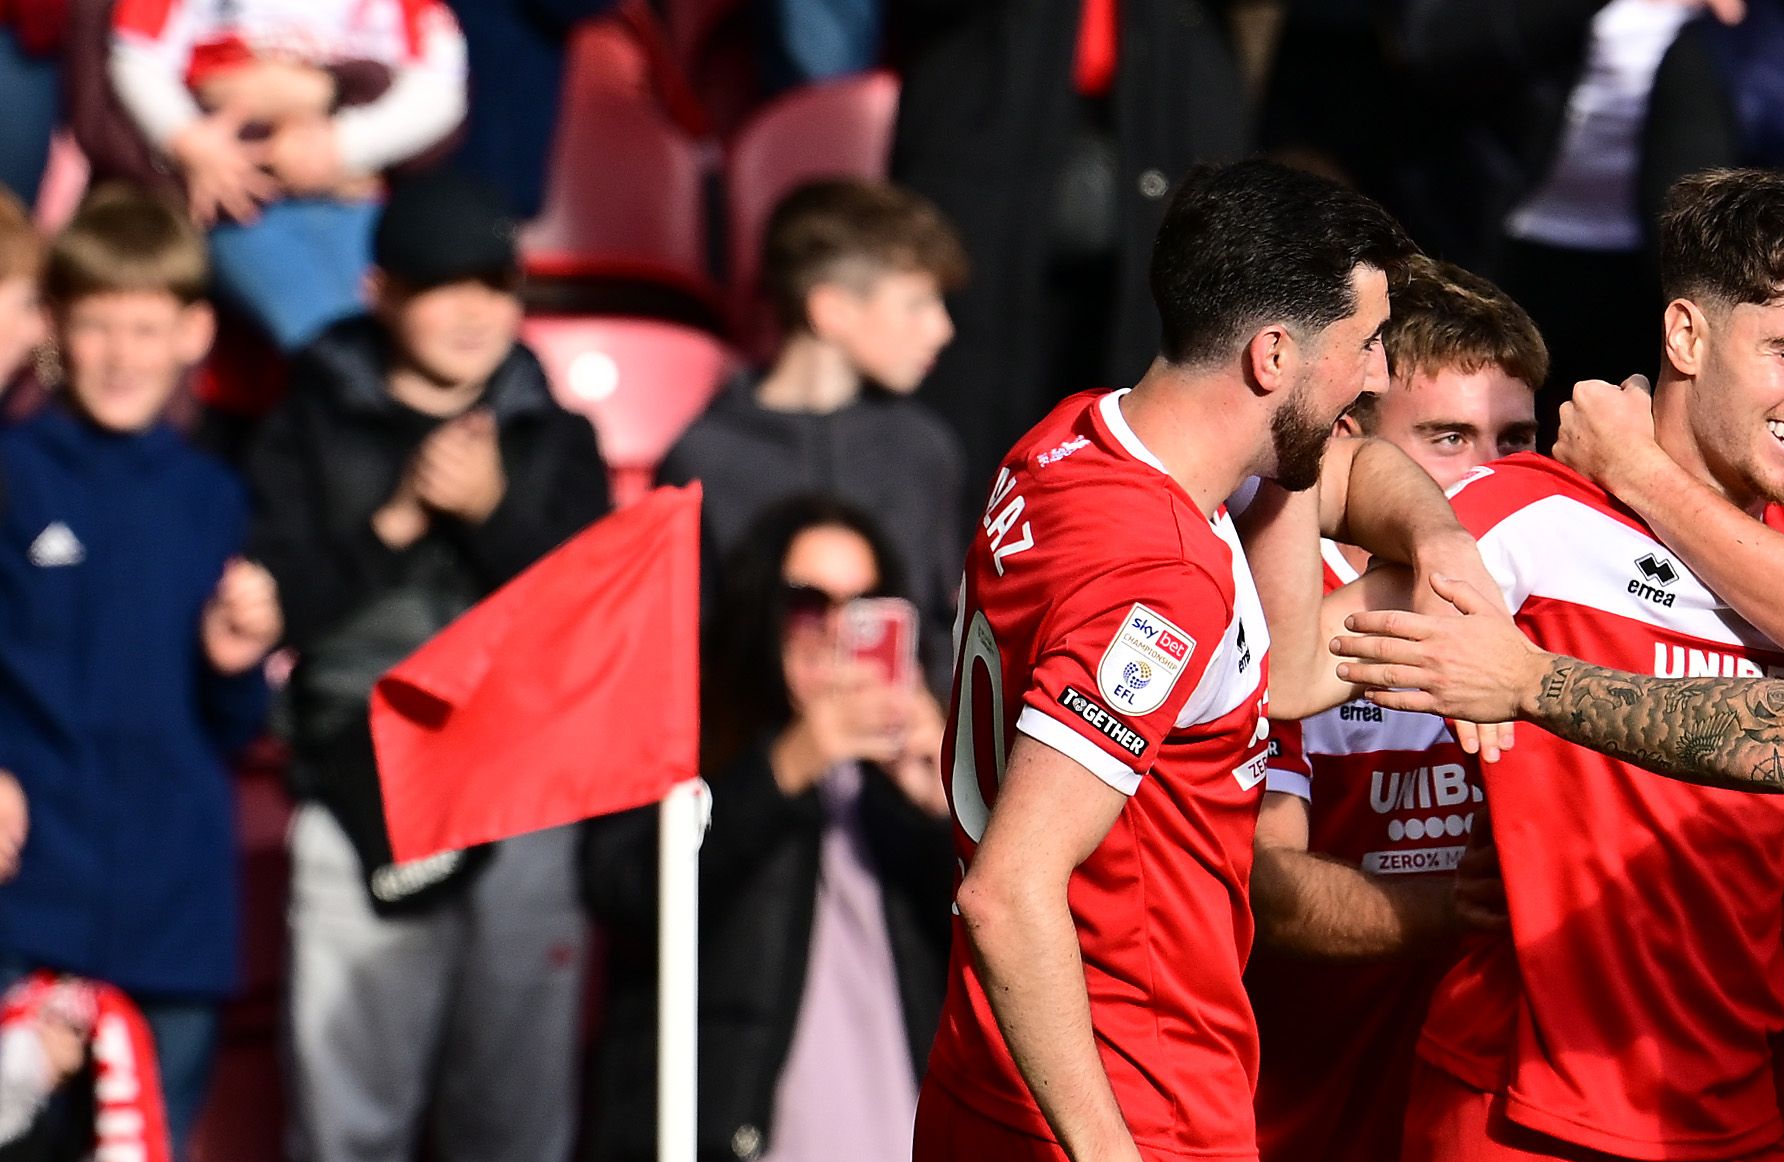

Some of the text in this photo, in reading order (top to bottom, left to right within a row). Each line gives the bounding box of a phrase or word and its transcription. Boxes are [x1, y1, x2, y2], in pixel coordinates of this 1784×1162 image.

[1123, 632, 1178, 671] CHAMPIONSHIP
[1132, 617, 1185, 658] sky bet
[1113, 684, 1136, 706] EFL
[1378, 852, 1440, 870] ZERO%
